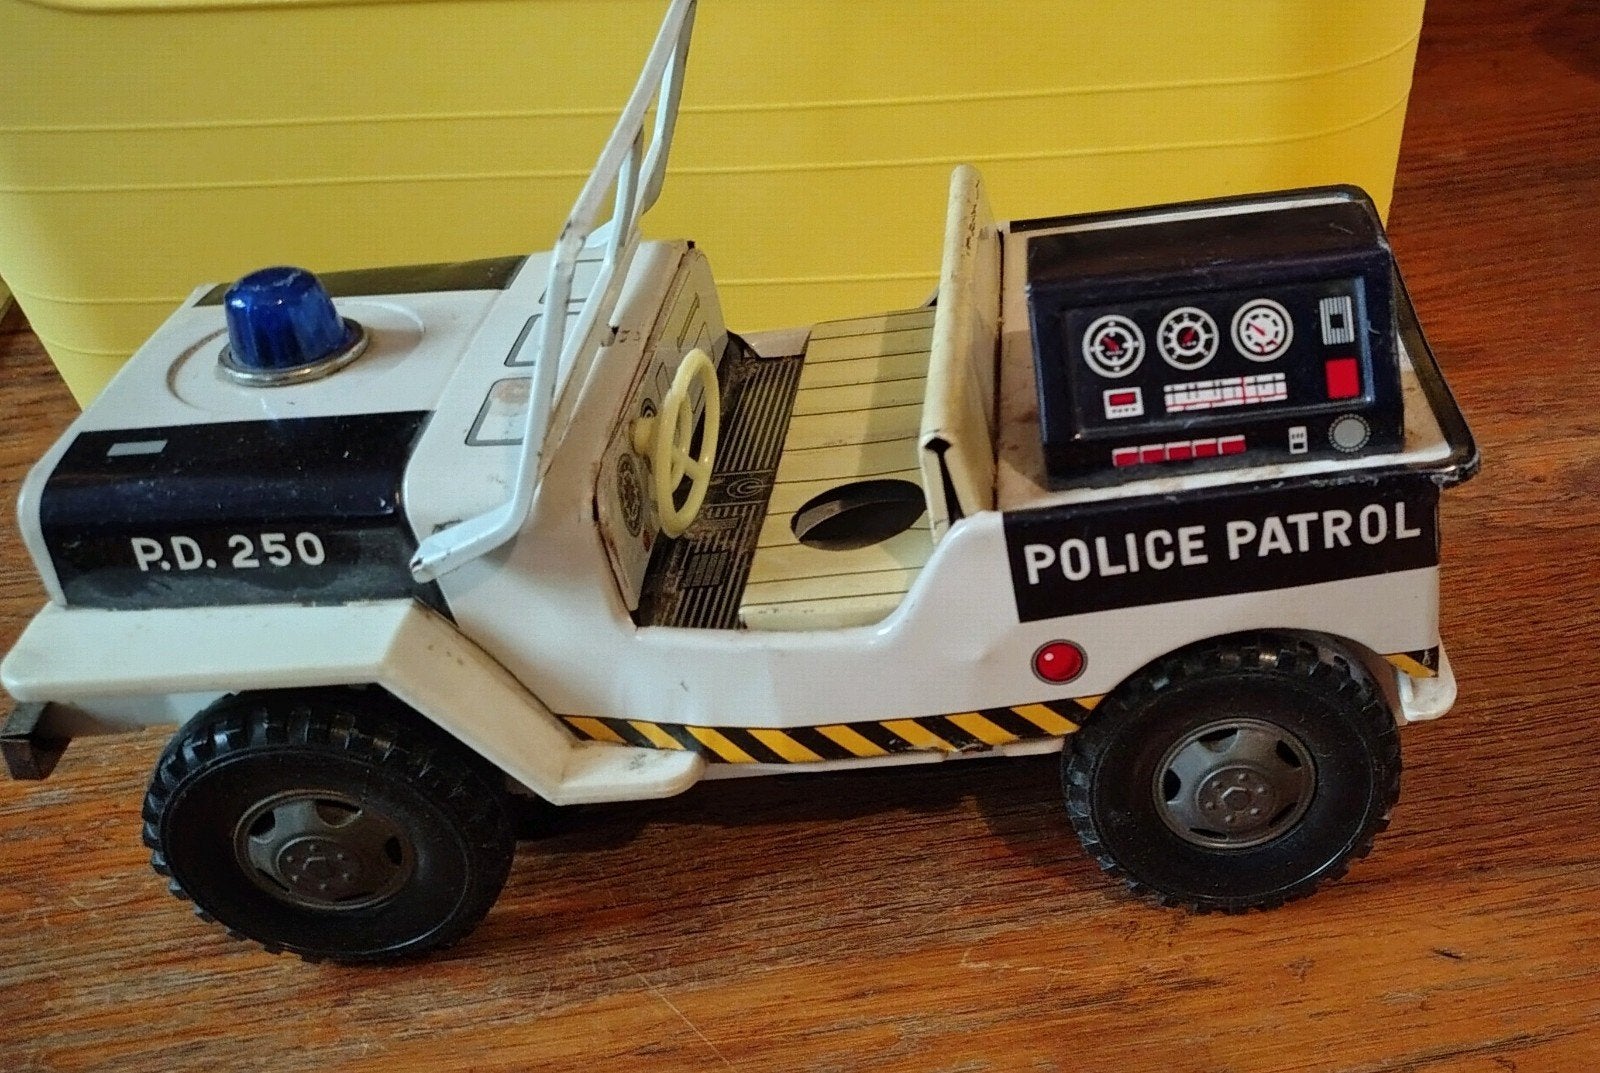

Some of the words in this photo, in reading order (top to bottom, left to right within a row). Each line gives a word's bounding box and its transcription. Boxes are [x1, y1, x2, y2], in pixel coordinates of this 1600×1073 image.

[131, 535, 217, 572] P.D.
[228, 531, 325, 568] 250
[1023, 525, 1208, 584] POLICE
[1226, 502, 1421, 560] PATROL
